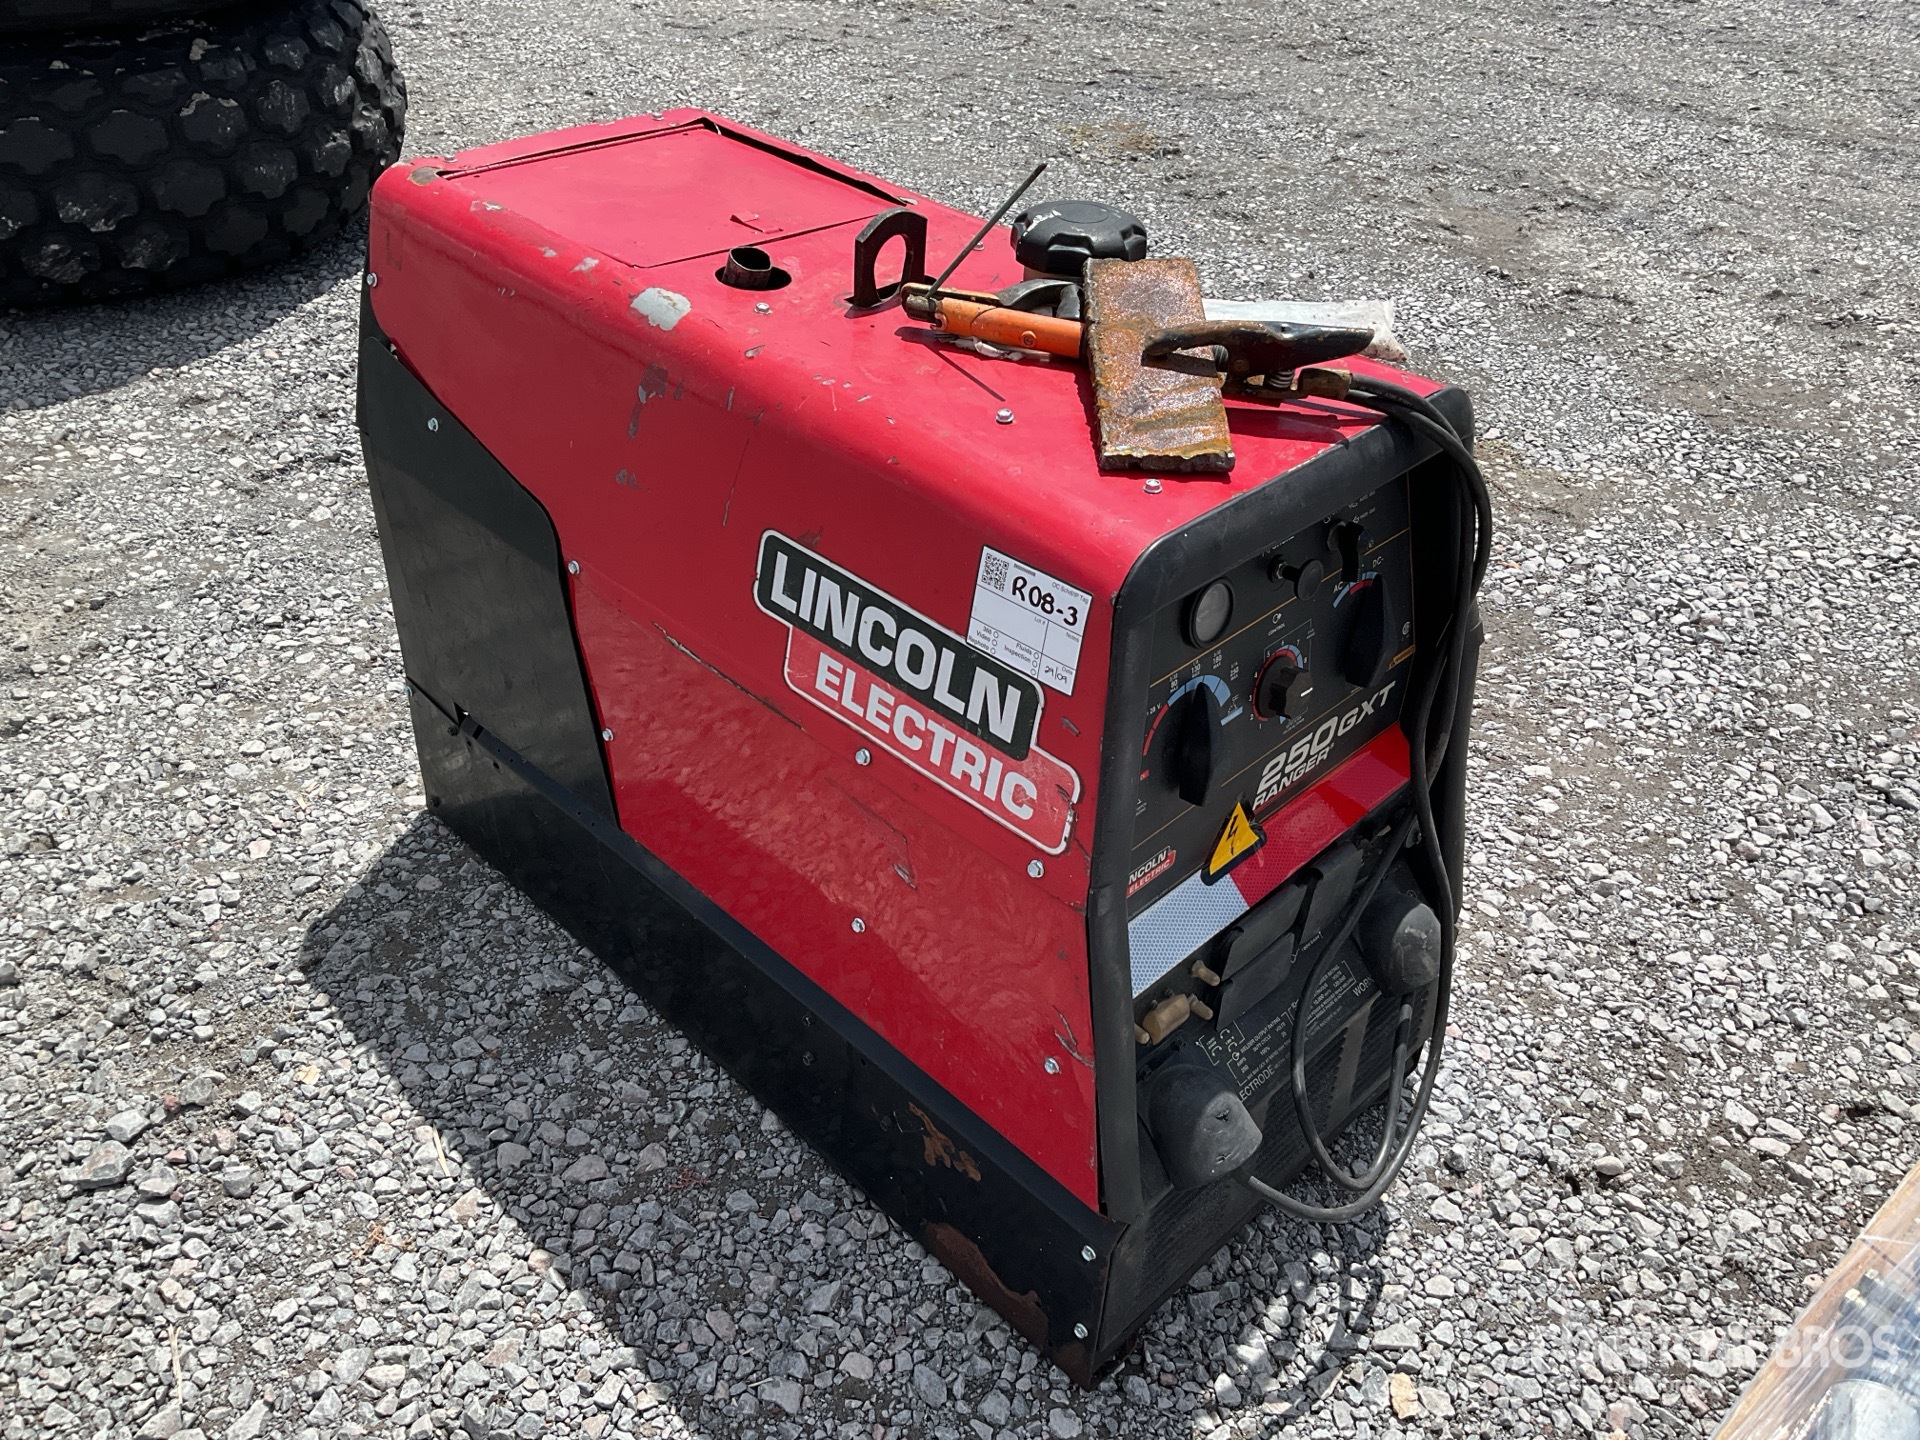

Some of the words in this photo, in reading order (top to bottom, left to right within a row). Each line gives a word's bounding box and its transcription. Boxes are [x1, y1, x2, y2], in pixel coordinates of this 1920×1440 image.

[1333, 581, 1343, 593] AC
[1012, 576, 1078, 626] R08-3
[1034, 616, 1042, 624] Lot
[969, 636, 989, 651] Rephoto
[976, 630, 991, 642] Video
[1066, 632, 1079, 643] Notes
[771, 551, 1021, 744] LINCOLN
[1004, 645, 1031, 663] Inspection
[1016, 643, 1032, 655] Fluids
[1062, 666, 1073, 675] Date
[815, 652, 1037, 820] ELECTRIC
[1257, 716, 1338, 794] 250
[1337, 681, 1396, 737] GXT
[1252, 747, 1330, 811] RANGER
[1129, 859, 1170, 894] ELECTRIC
[1240, 1039, 1255, 1053] WELDER
[1254, 1027, 1268, 1041] OUTPUT
[1267, 1016, 1281, 1029] RATING
[1260, 1034, 1272, 1045] CYCLE
[1239, 1064, 1275, 1102] ECTRODE
